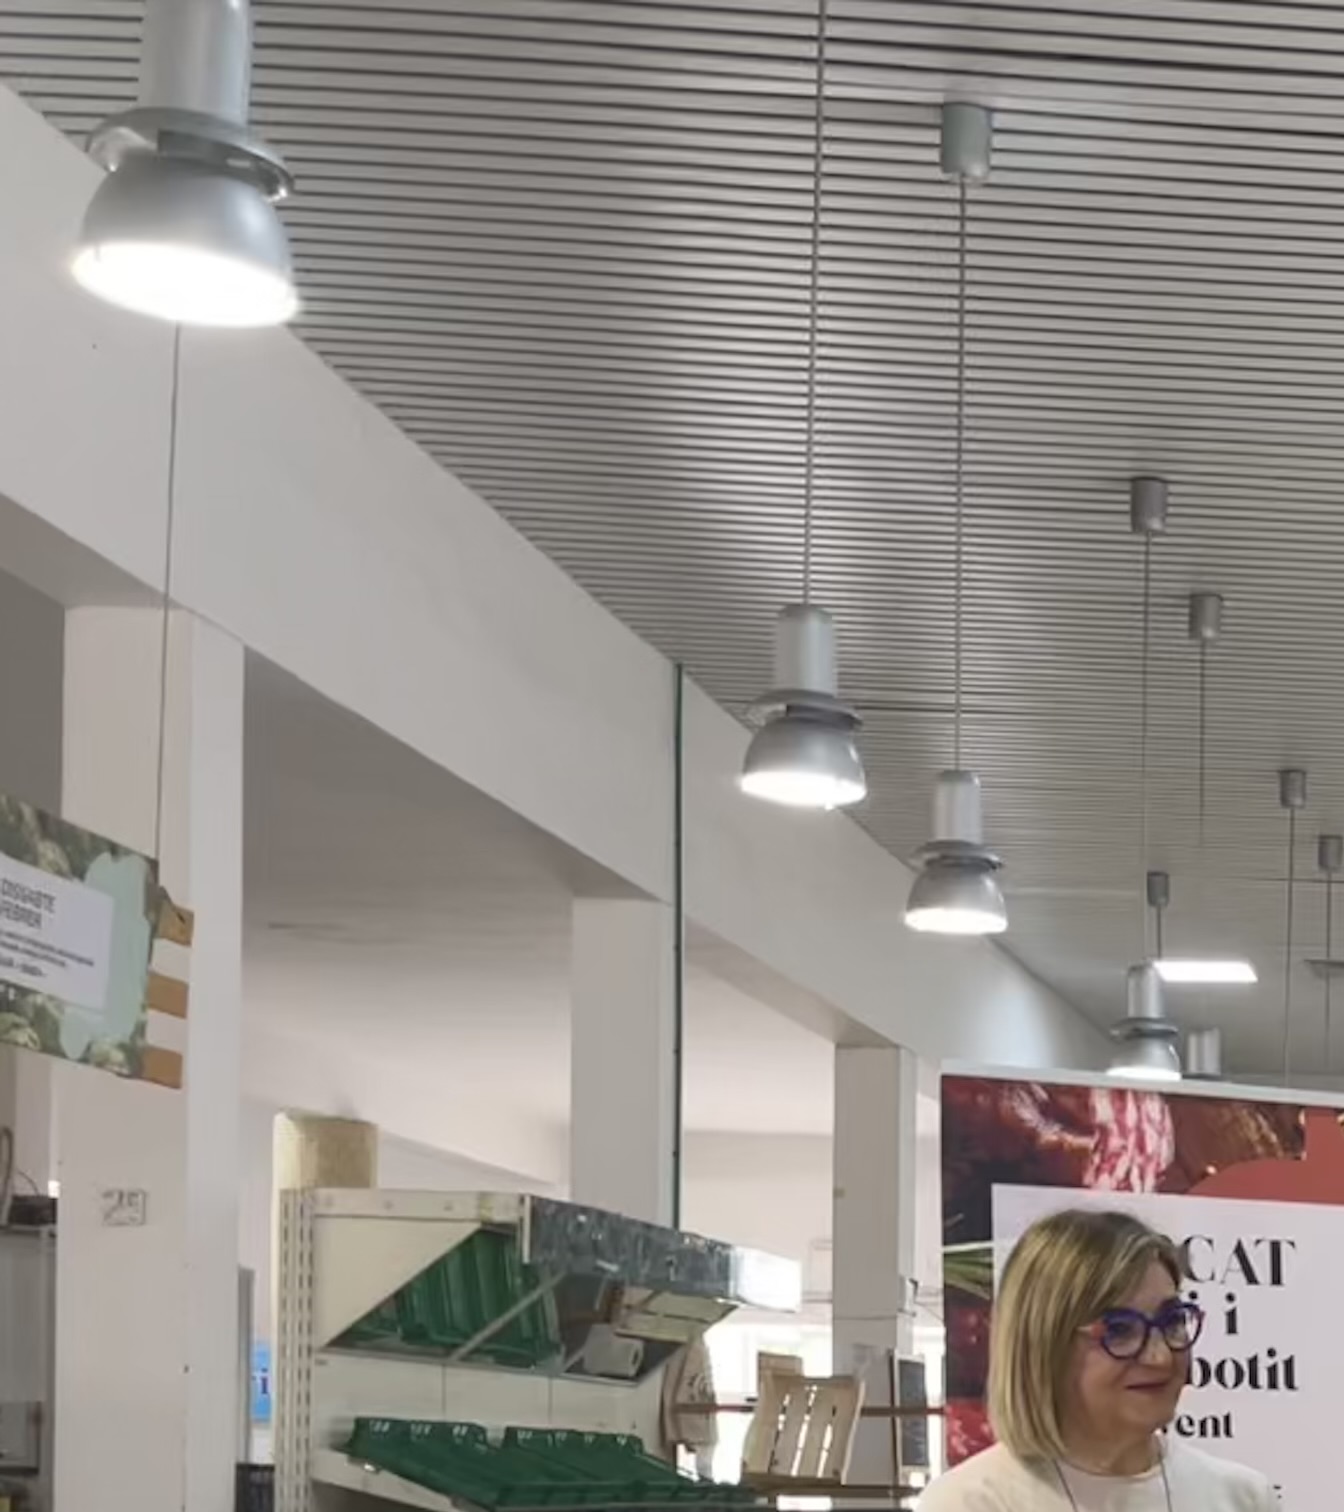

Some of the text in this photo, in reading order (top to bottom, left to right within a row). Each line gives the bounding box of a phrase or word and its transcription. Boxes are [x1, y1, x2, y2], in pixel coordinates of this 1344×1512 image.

[1182, 1235, 1297, 1287] CAT
[1225, 1292, 1239, 1335] i
[1187, 1347, 1299, 1391] botit
